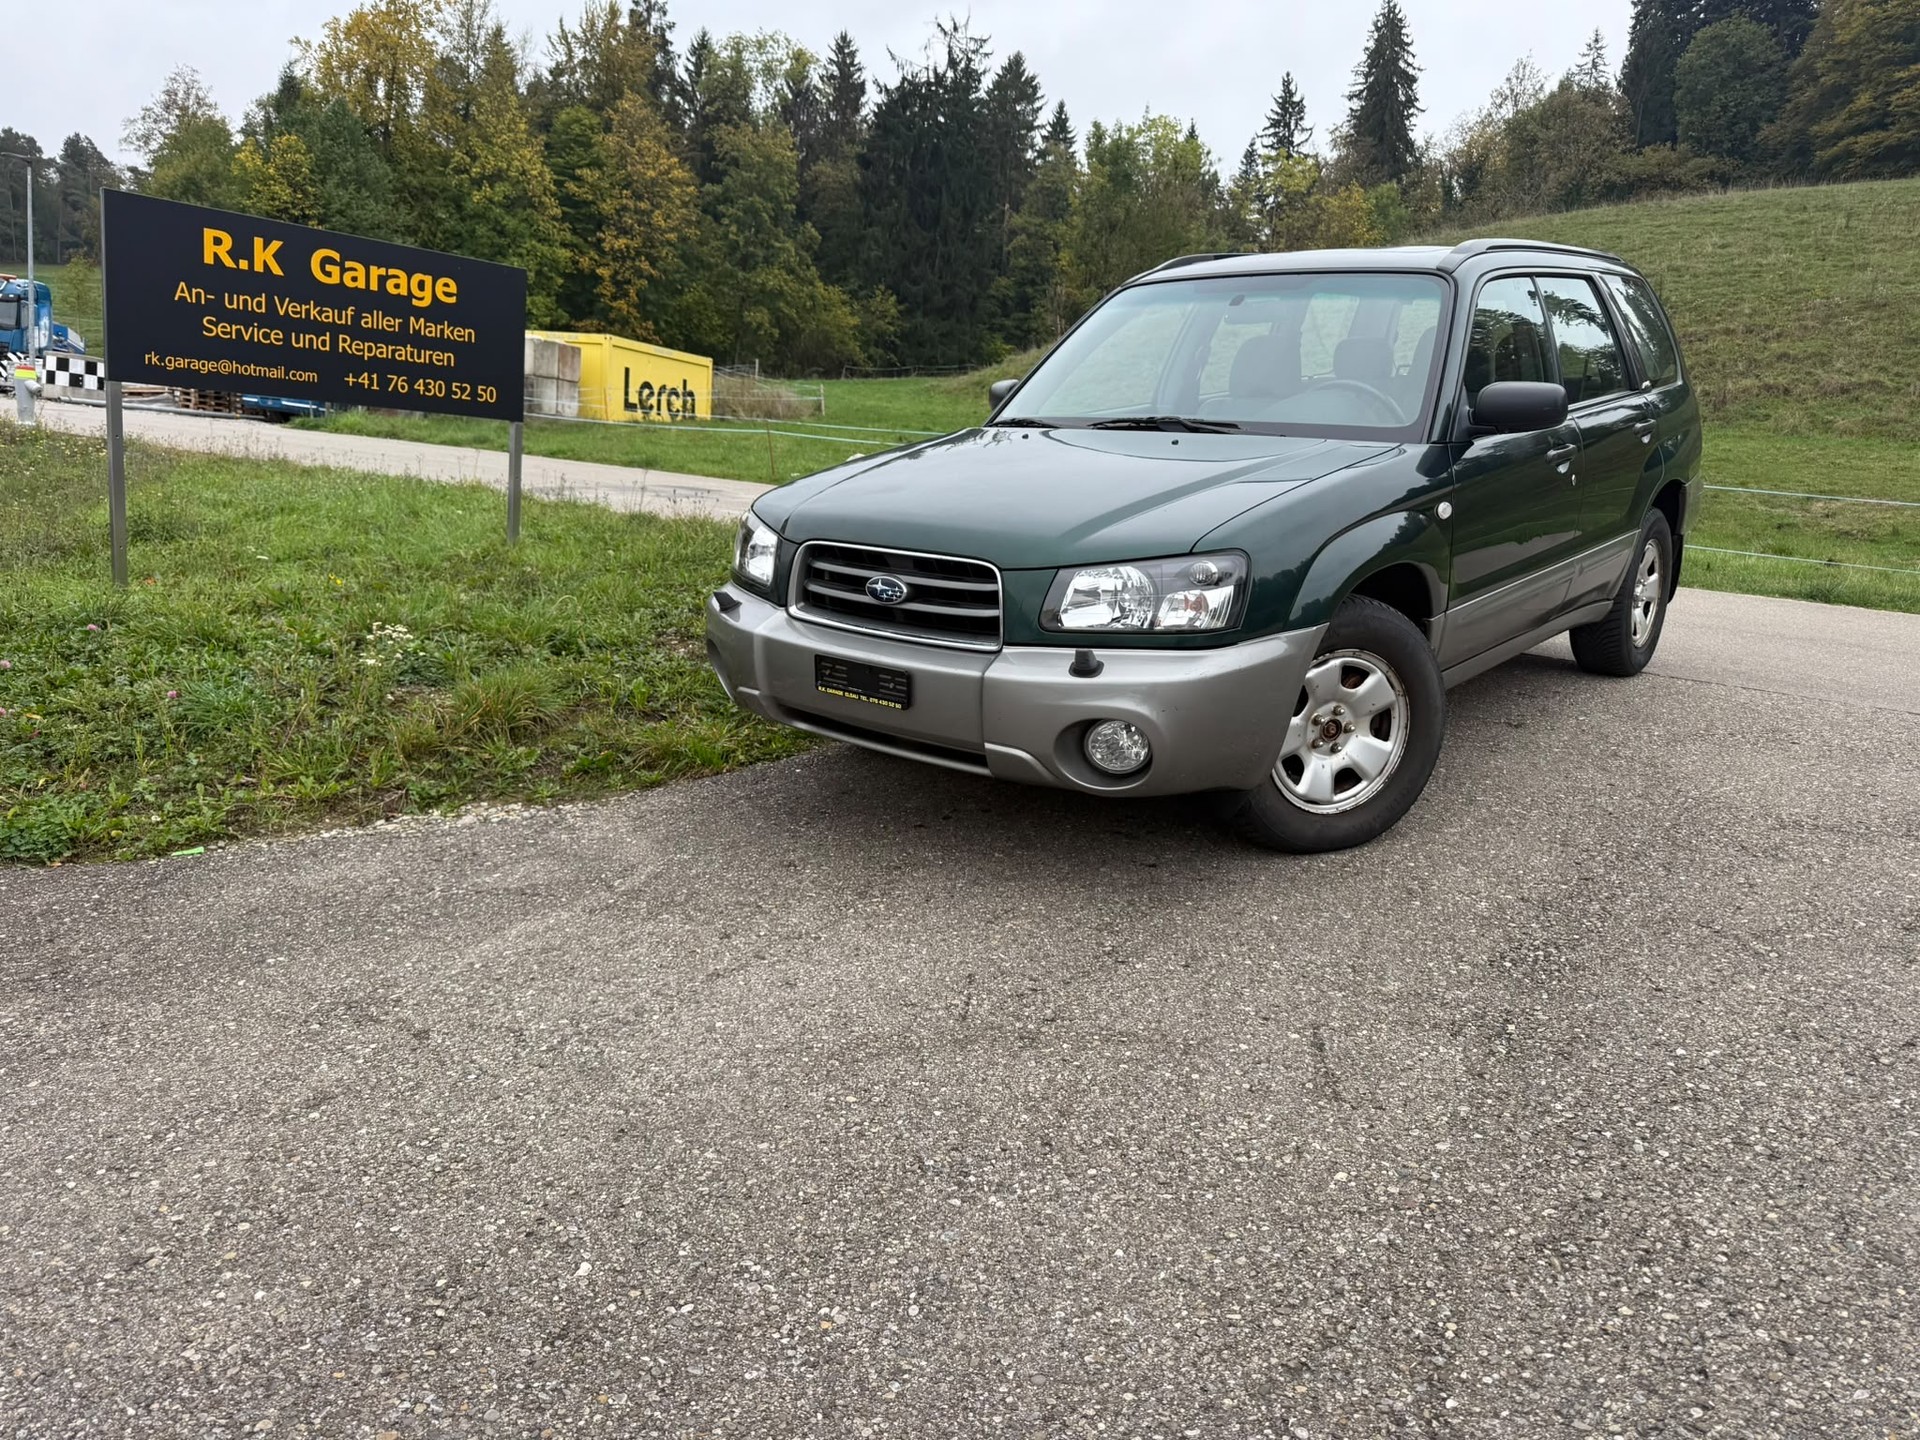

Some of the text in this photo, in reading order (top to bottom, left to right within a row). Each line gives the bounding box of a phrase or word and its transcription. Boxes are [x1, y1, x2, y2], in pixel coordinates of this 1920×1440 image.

[203, 227, 458, 308] R.K Garage
[174, 281, 476, 343] An- und Verkauf aller Marken
[203, 316, 456, 367] Service und Reparaturen
[145, 353, 318, 382] rk.garage@hotmail.com
[344, 372, 497, 403] +41 76 430 52 50
[624, 367, 696, 419] Lerch
